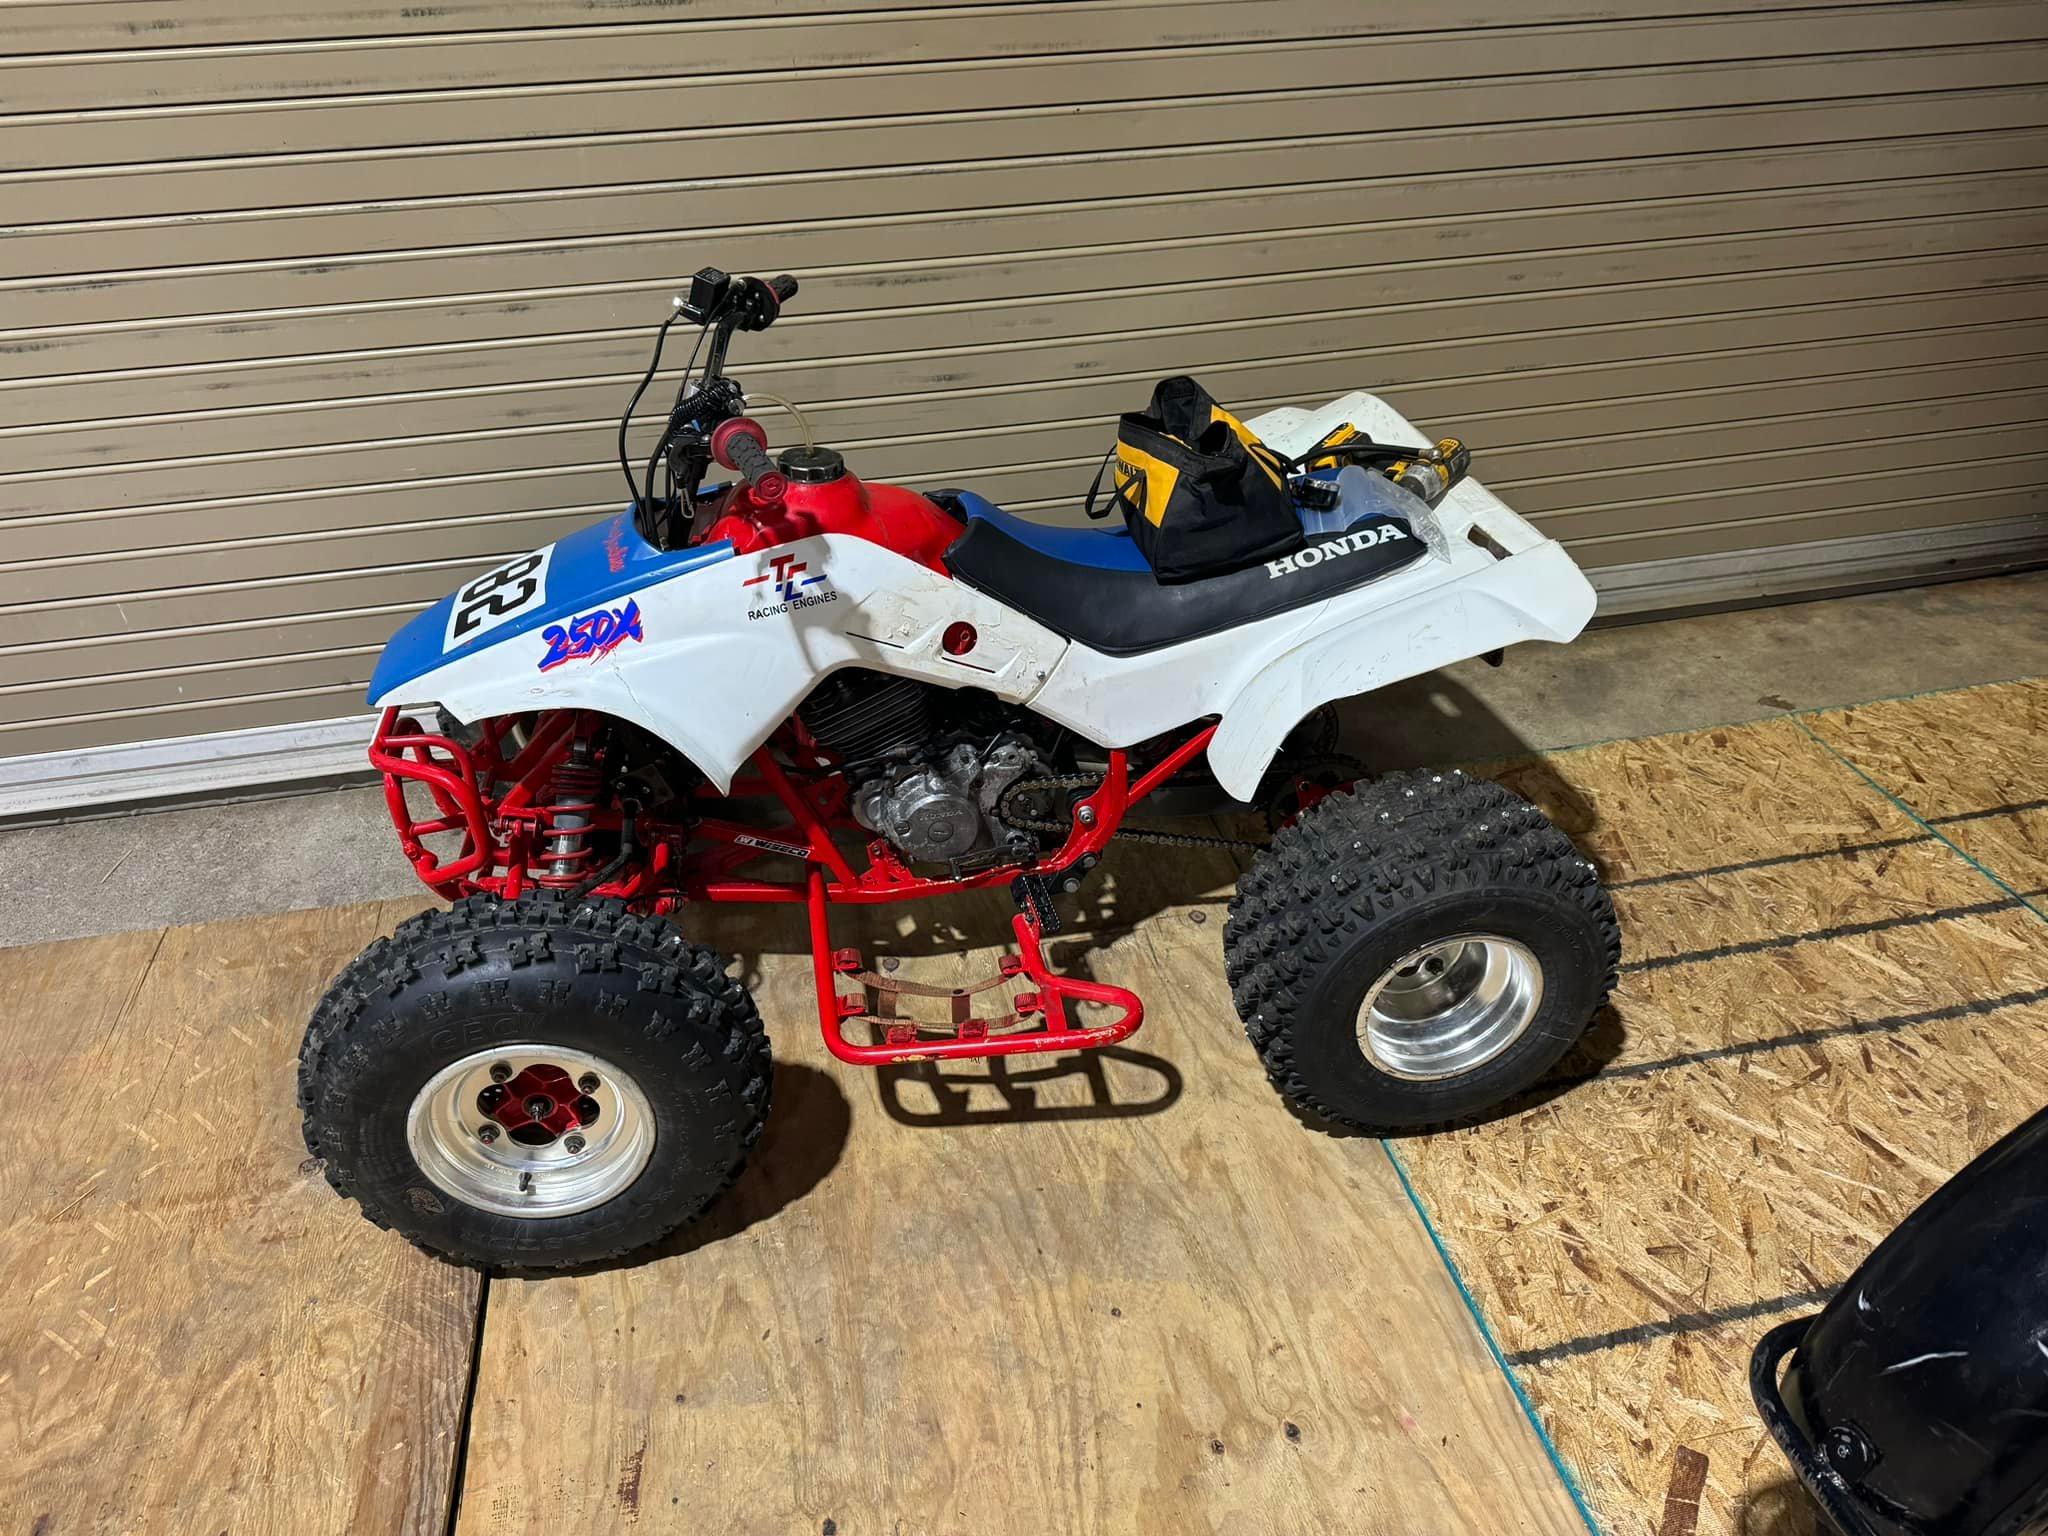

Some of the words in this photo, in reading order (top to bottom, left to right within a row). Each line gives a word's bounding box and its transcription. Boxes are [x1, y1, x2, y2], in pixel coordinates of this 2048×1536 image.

[1264, 524, 1408, 579] HONDA
[453, 554, 543, 639] 82
[747, 603, 788, 621] RACING
[793, 591, 838, 610] ENGINES
[537, 597, 643, 673] 250X
